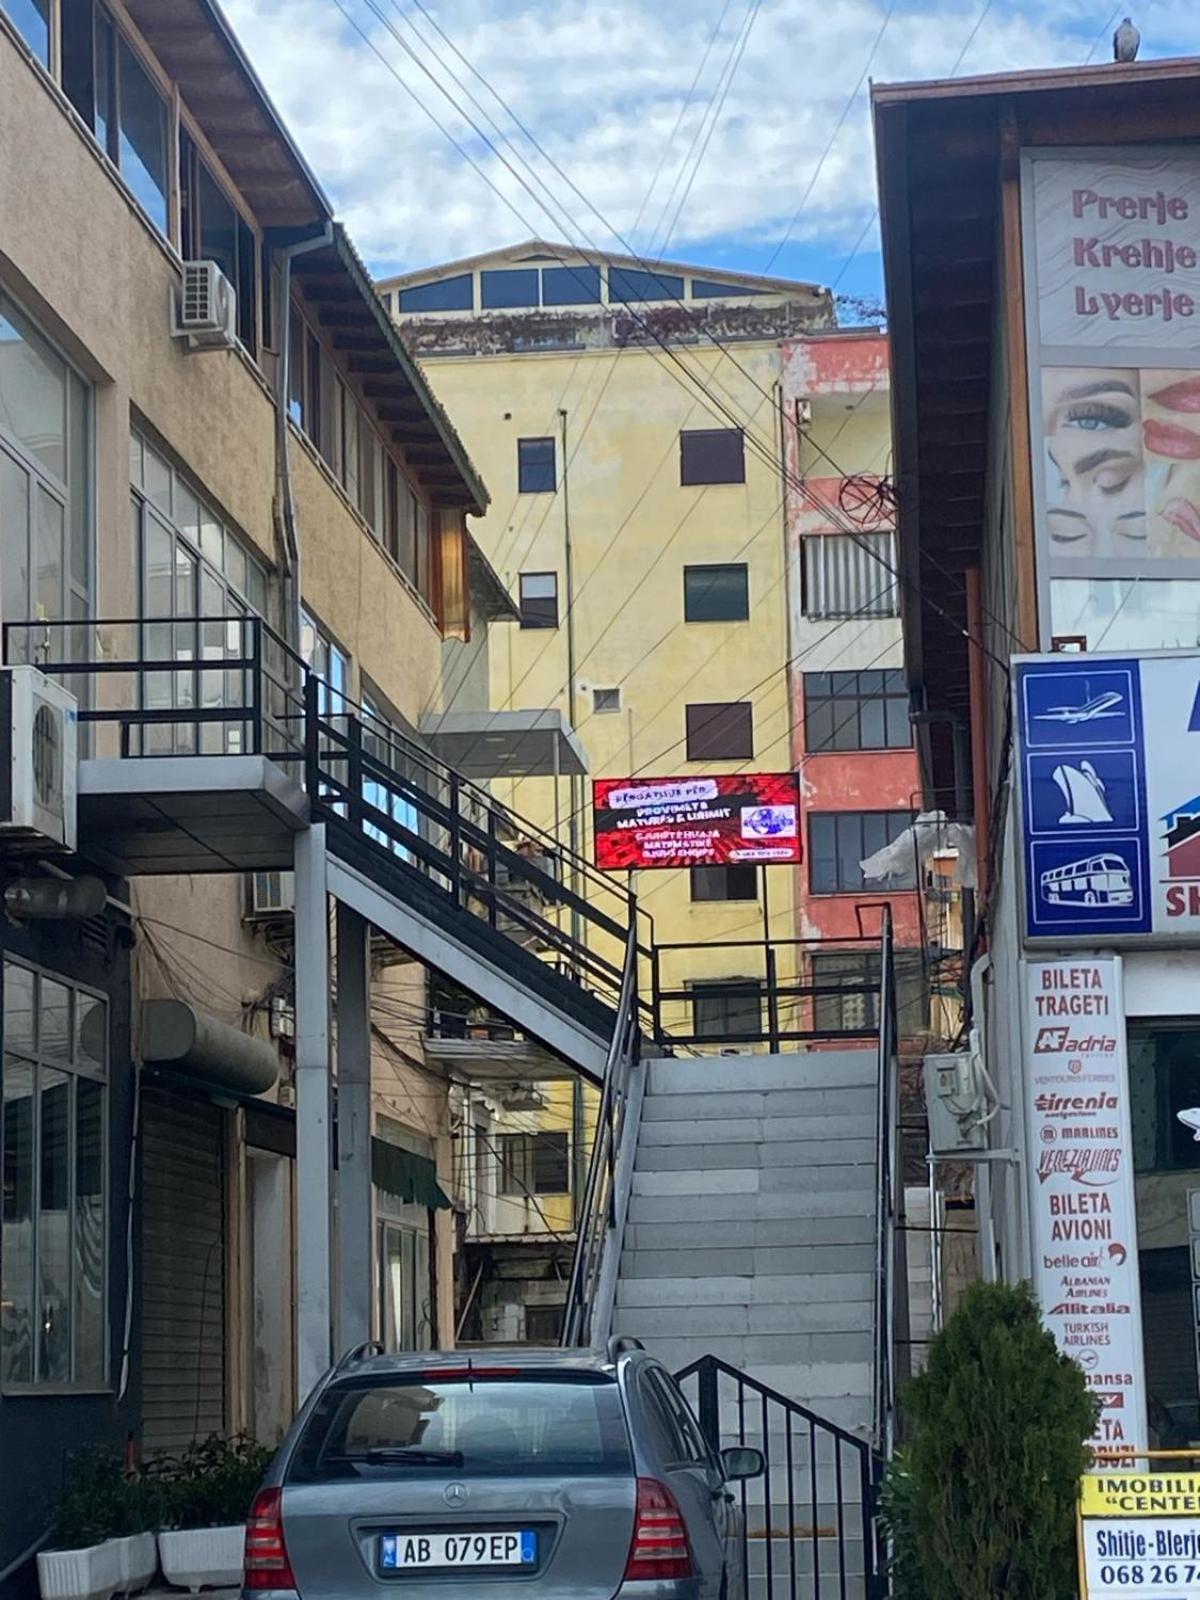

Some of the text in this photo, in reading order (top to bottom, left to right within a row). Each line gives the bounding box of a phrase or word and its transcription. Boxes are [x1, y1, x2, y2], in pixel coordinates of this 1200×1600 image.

[1072, 189, 1189, 225] Prerje
[1072, 237, 1197, 273] Krehje
[1075, 286, 1195, 322] Lyerje
[1042, 968, 1102, 990] BILETA
[1035, 994, 1109, 1017] TRAGETI
[1064, 1035, 1117, 1052] adria
[1034, 1091, 1118, 1112] tirrenia
[1050, 1192, 1111, 1216] BILETA
[1051, 1219, 1112, 1242] AVIONI
[1043, 1254, 1079, 1269] belle
[1048, 1302, 1131, 1315] Alitalia
[1063, 1322, 1109, 1334] TURKISH
[1063, 1334, 1111, 1346] AIRLINES
[1098, 1479, 1200, 1494] IMOBILI
[1106, 1496, 1200, 1511] “CENTE
[404, 1538, 431, 1563] AB
[1100, 1565, 1200, 1585] 068 26 7
